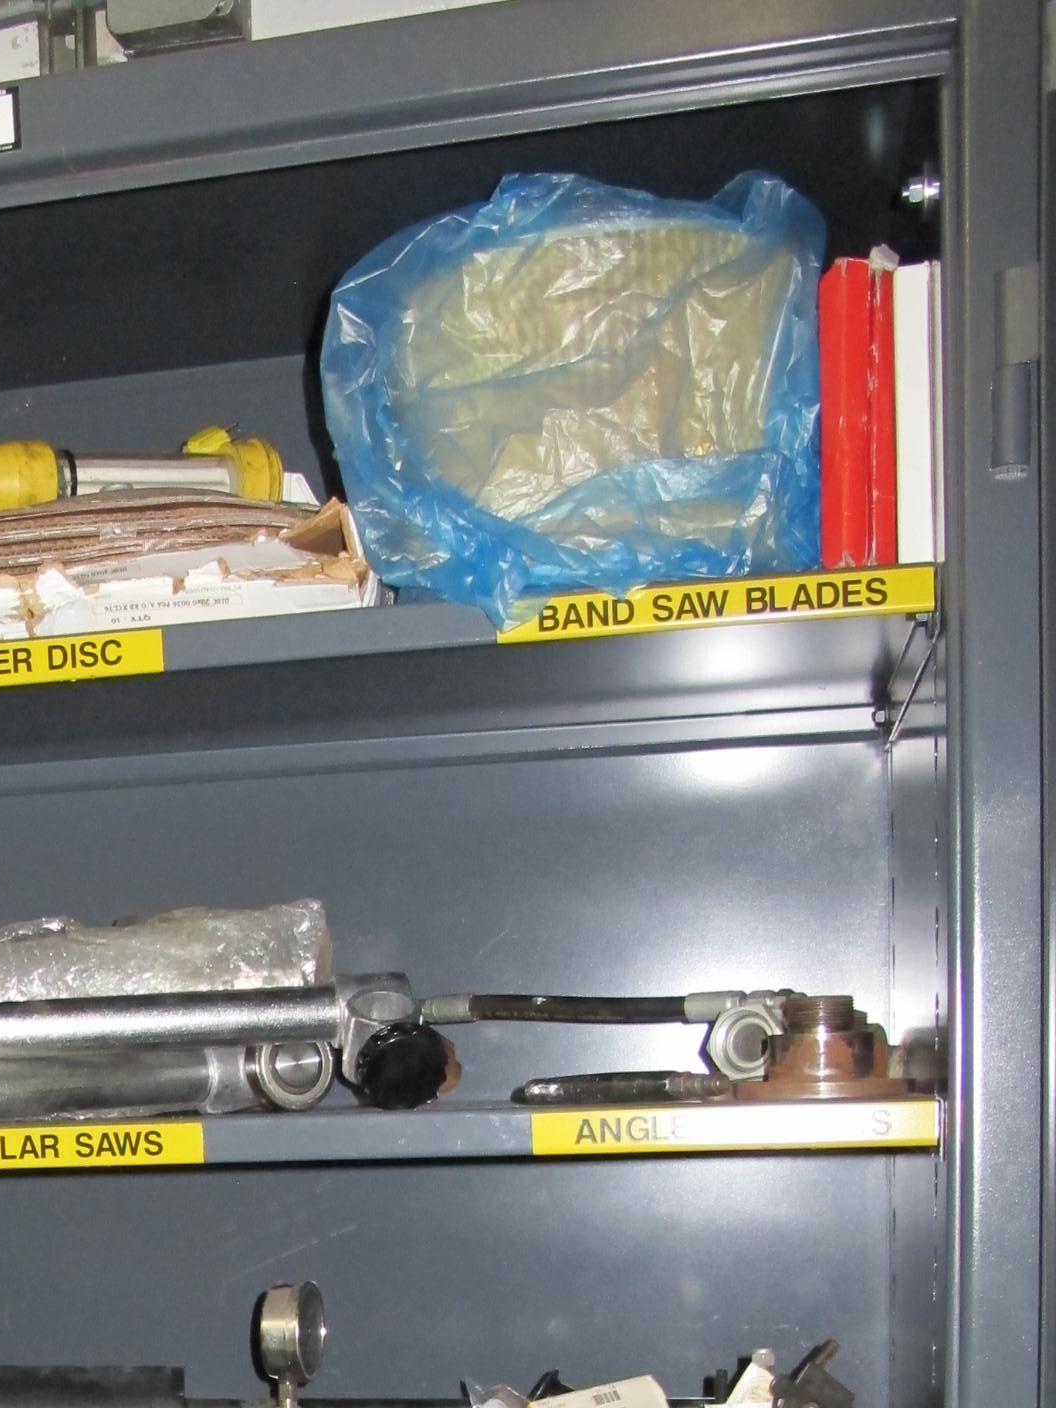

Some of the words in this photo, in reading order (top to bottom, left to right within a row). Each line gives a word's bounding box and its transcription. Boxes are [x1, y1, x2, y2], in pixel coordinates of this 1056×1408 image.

[538, 599, 635, 633] BAND
[653, 590, 729, 622] SAW
[745, 577, 889, 614] BLADES
[47, 639, 123, 672] DISC
[75, 1130, 164, 1158] SAWS
